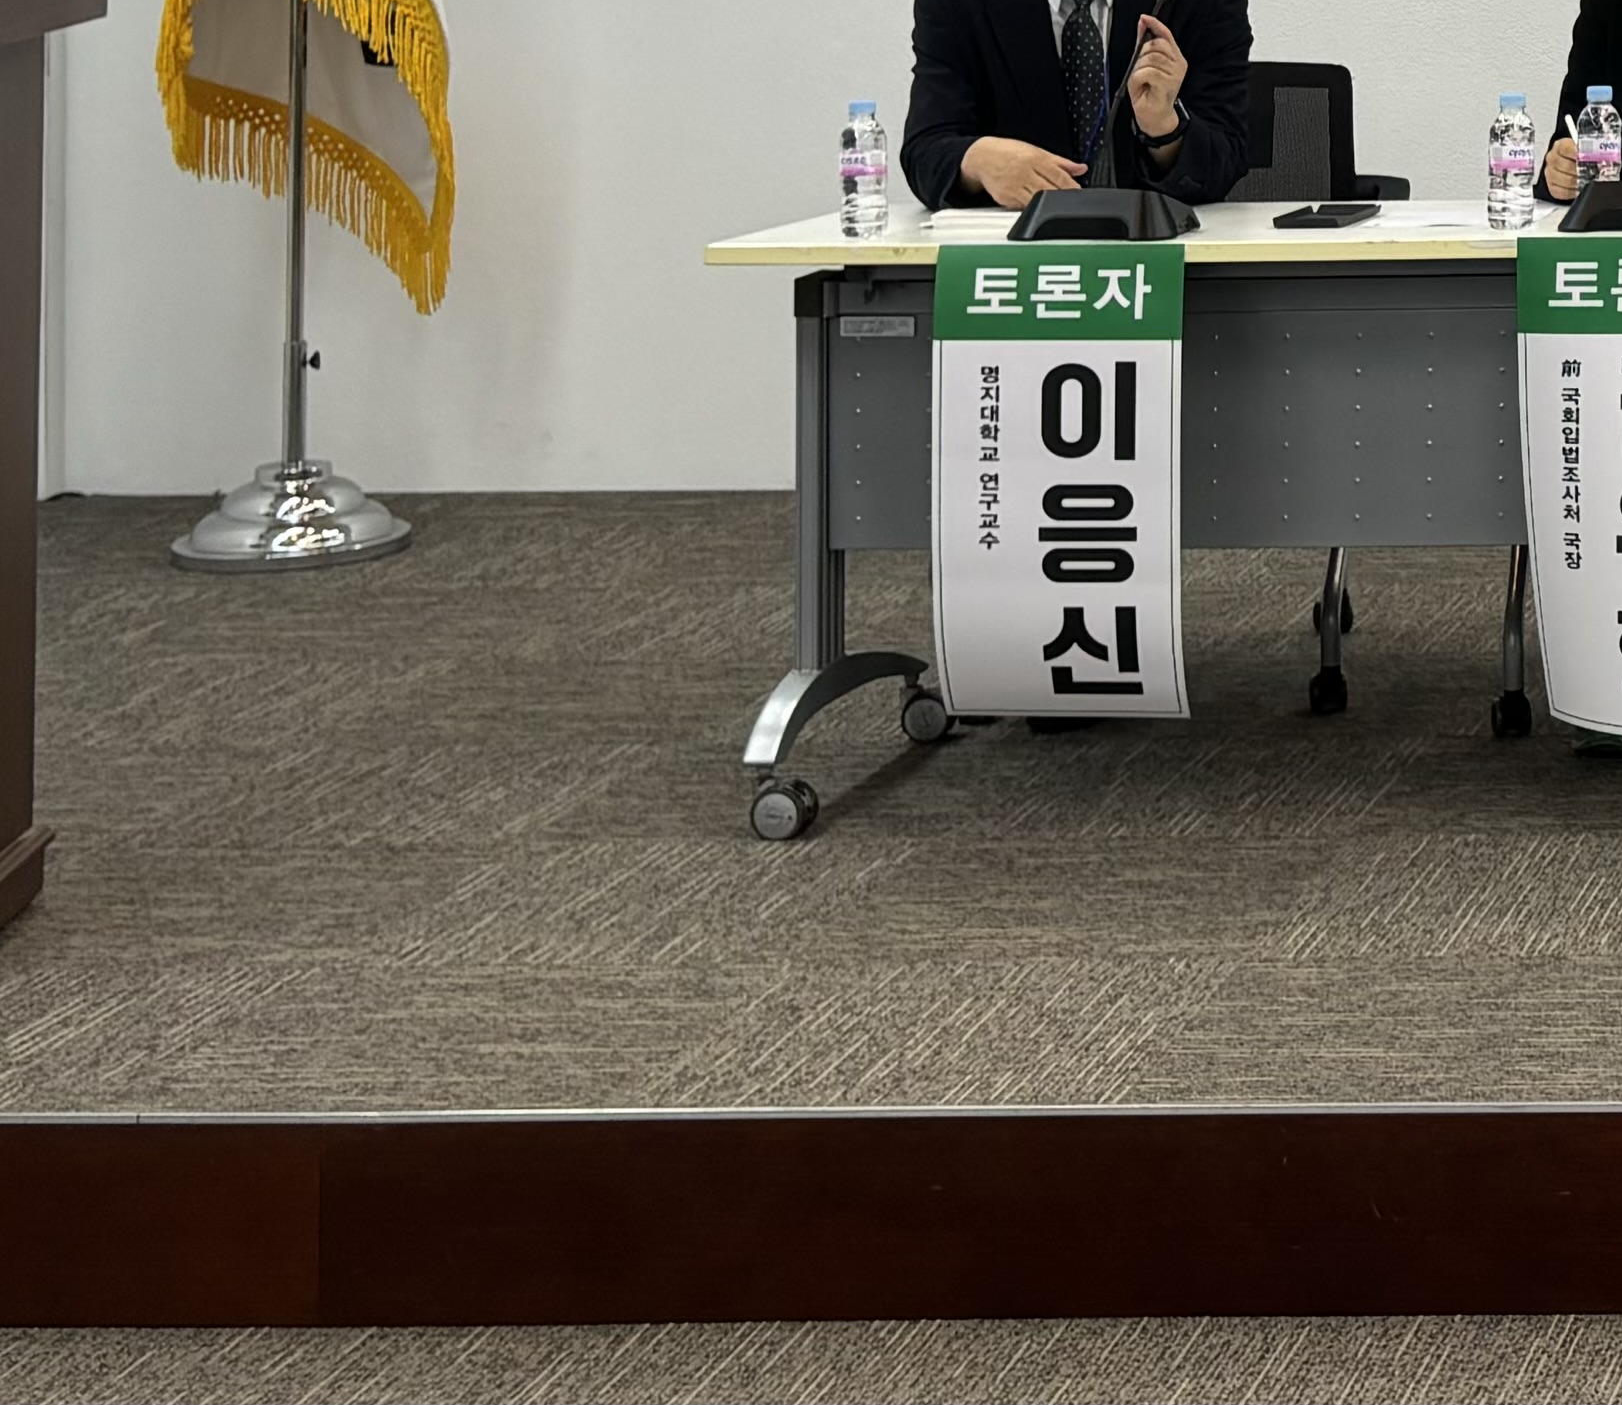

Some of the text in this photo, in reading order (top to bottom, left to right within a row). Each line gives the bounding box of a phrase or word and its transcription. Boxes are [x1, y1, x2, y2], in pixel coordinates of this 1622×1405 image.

[966, 263, 1152, 320] 토론자
[978, 365, 1000, 550] 명지대학교 연구교수
[1038, 361, 1145, 696] 이응신
[1561, 359, 1582, 570] 前 국회입법조사처 국장
